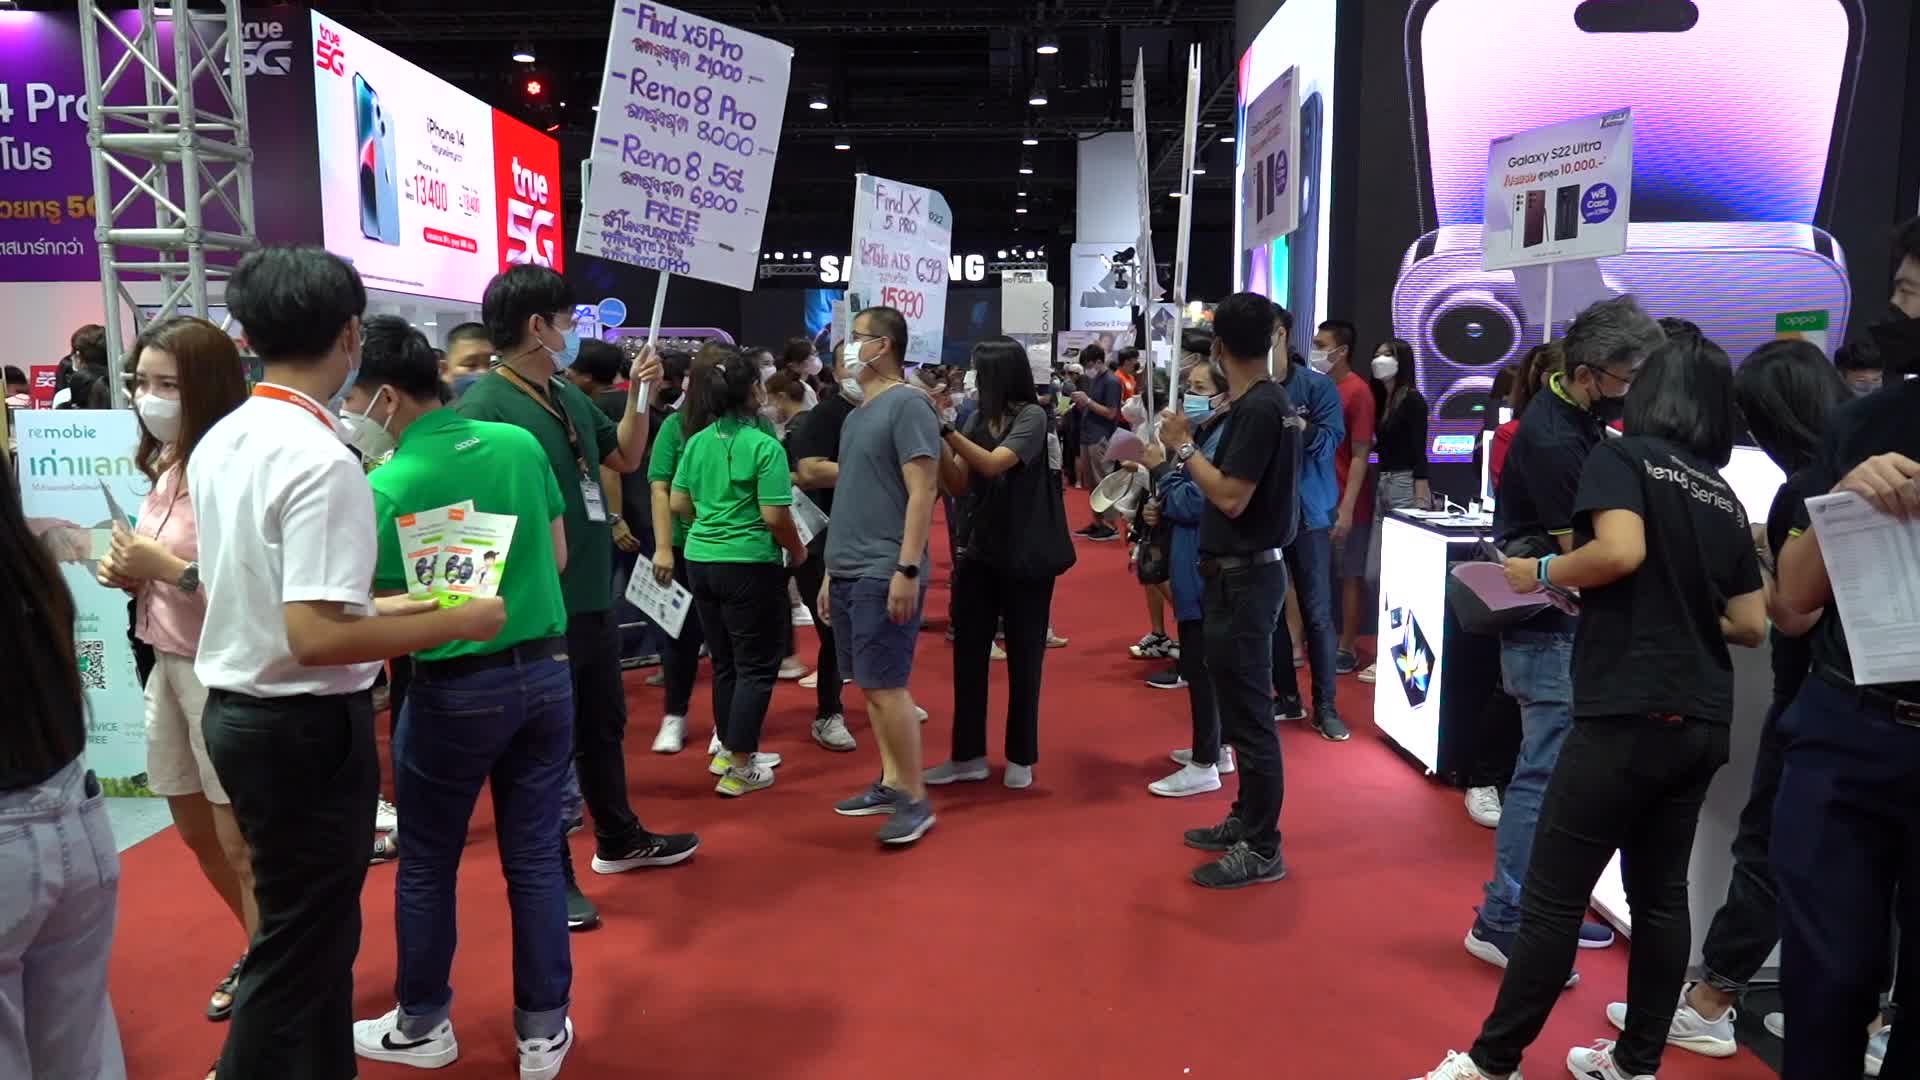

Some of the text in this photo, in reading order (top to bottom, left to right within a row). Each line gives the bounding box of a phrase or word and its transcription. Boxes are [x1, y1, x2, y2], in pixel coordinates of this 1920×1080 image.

[319, 22, 341, 47] true
[316, 39, 345, 77] 5G
[718, 95, 757, 130] Pro
[1507, 141, 1602, 168] Galaxy S22 Ultra
[511, 156, 549, 205] true
[876, 183, 904, 215] Find
[505, 197, 556, 267] 5G
[645, 199, 701, 233] FREE
[28, 423, 97, 439] remobie
[1690, 481, 1735, 513] Series
